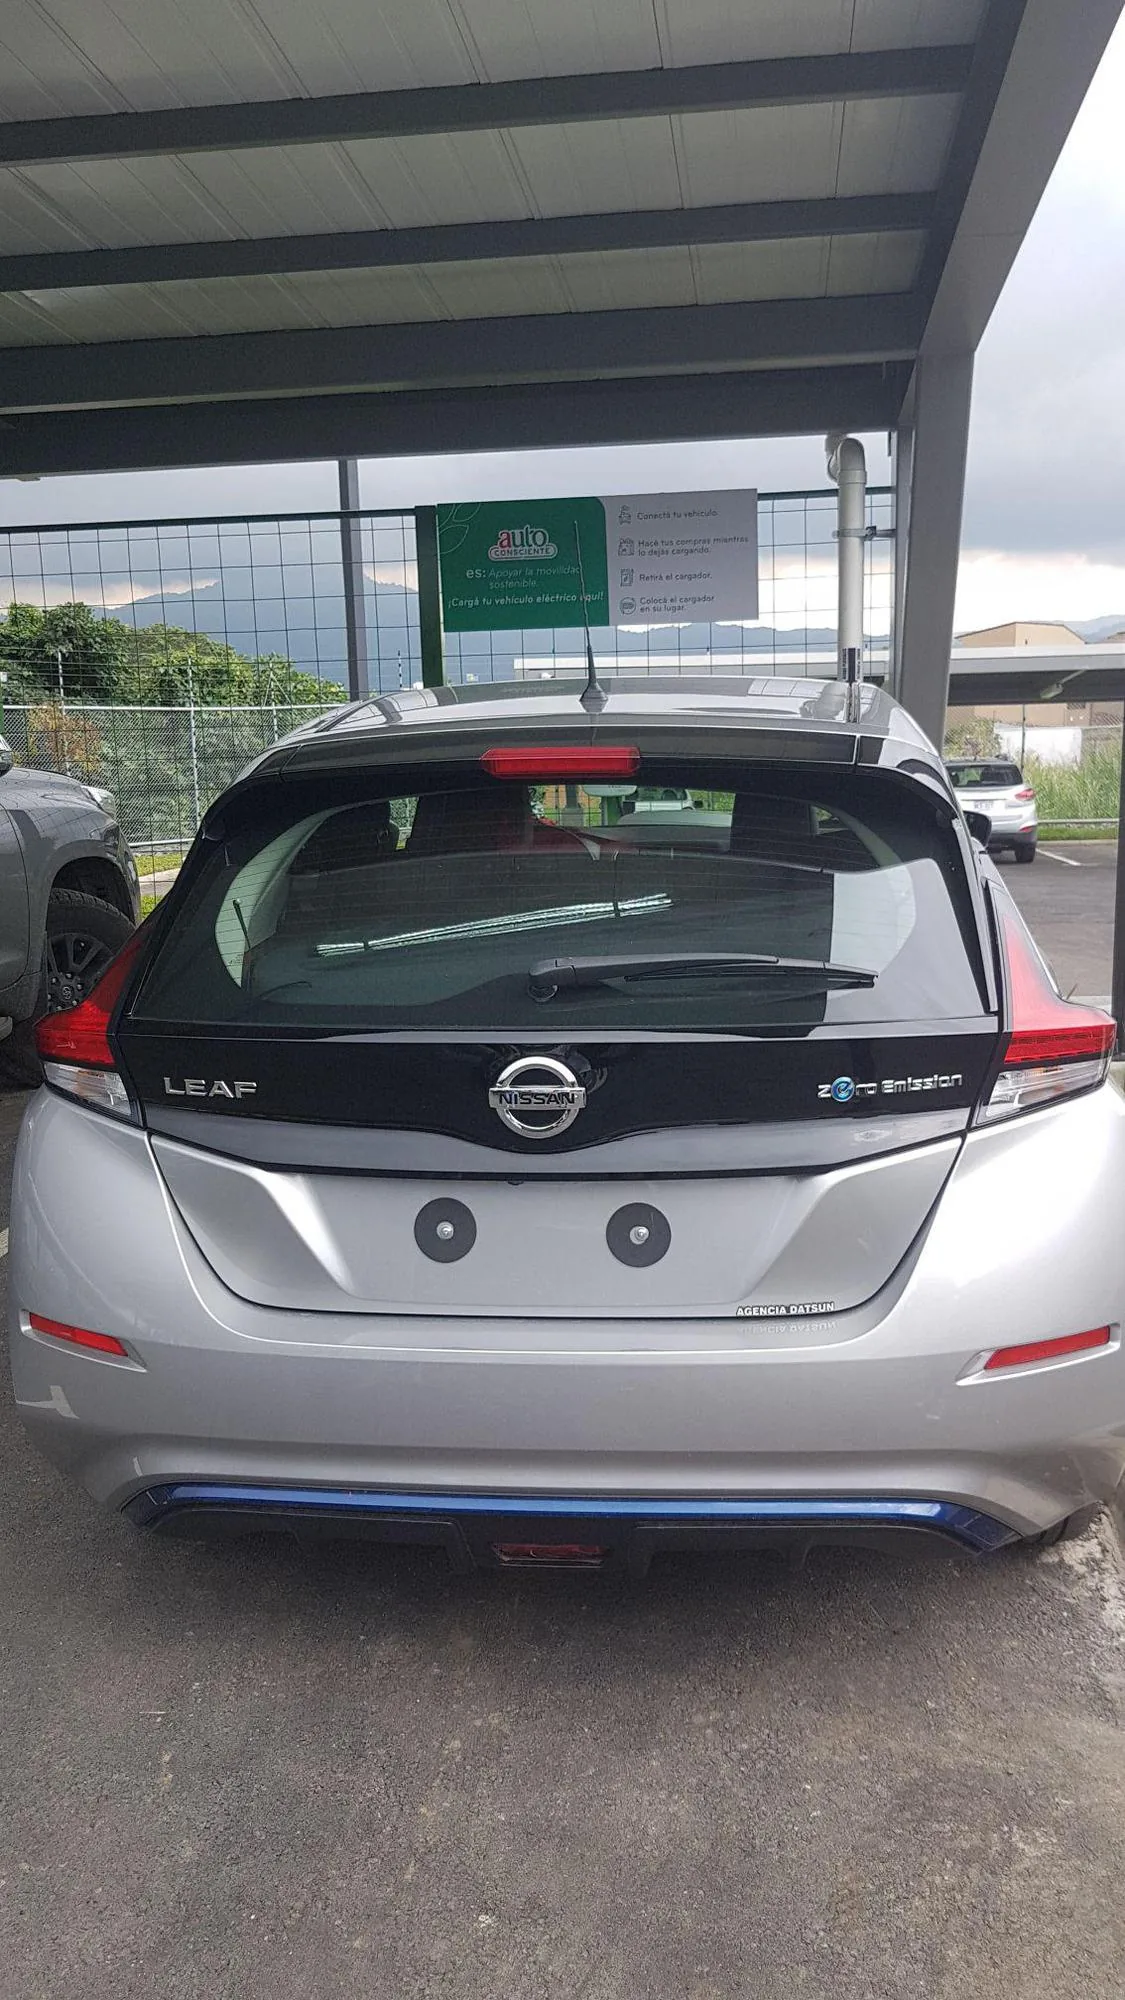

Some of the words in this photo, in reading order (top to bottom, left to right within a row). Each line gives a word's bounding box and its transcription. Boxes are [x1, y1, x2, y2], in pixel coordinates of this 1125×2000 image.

[499, 525, 548, 548] auto
[675, 538, 710, 548] compras
[713, 536, 749, 544] mientras
[494, 547, 551, 557] CONSCIENTE
[466, 569, 486, 579] es:
[489, 568, 522, 579] Apoyar
[526, 567, 534, 576] la
[674, 571, 713, 582] cargador.
[482, 597, 493, 606] tu
[679, 595, 715, 605] cargador
[163, 1077, 257, 1098] LEAF
[881, 1074, 962, 1093] Emission
[499, 1092, 575, 1105] NISSAN
[736, 1306, 787, 1317] AGENCIA
[789, 1302, 834, 1315] DATSUN
